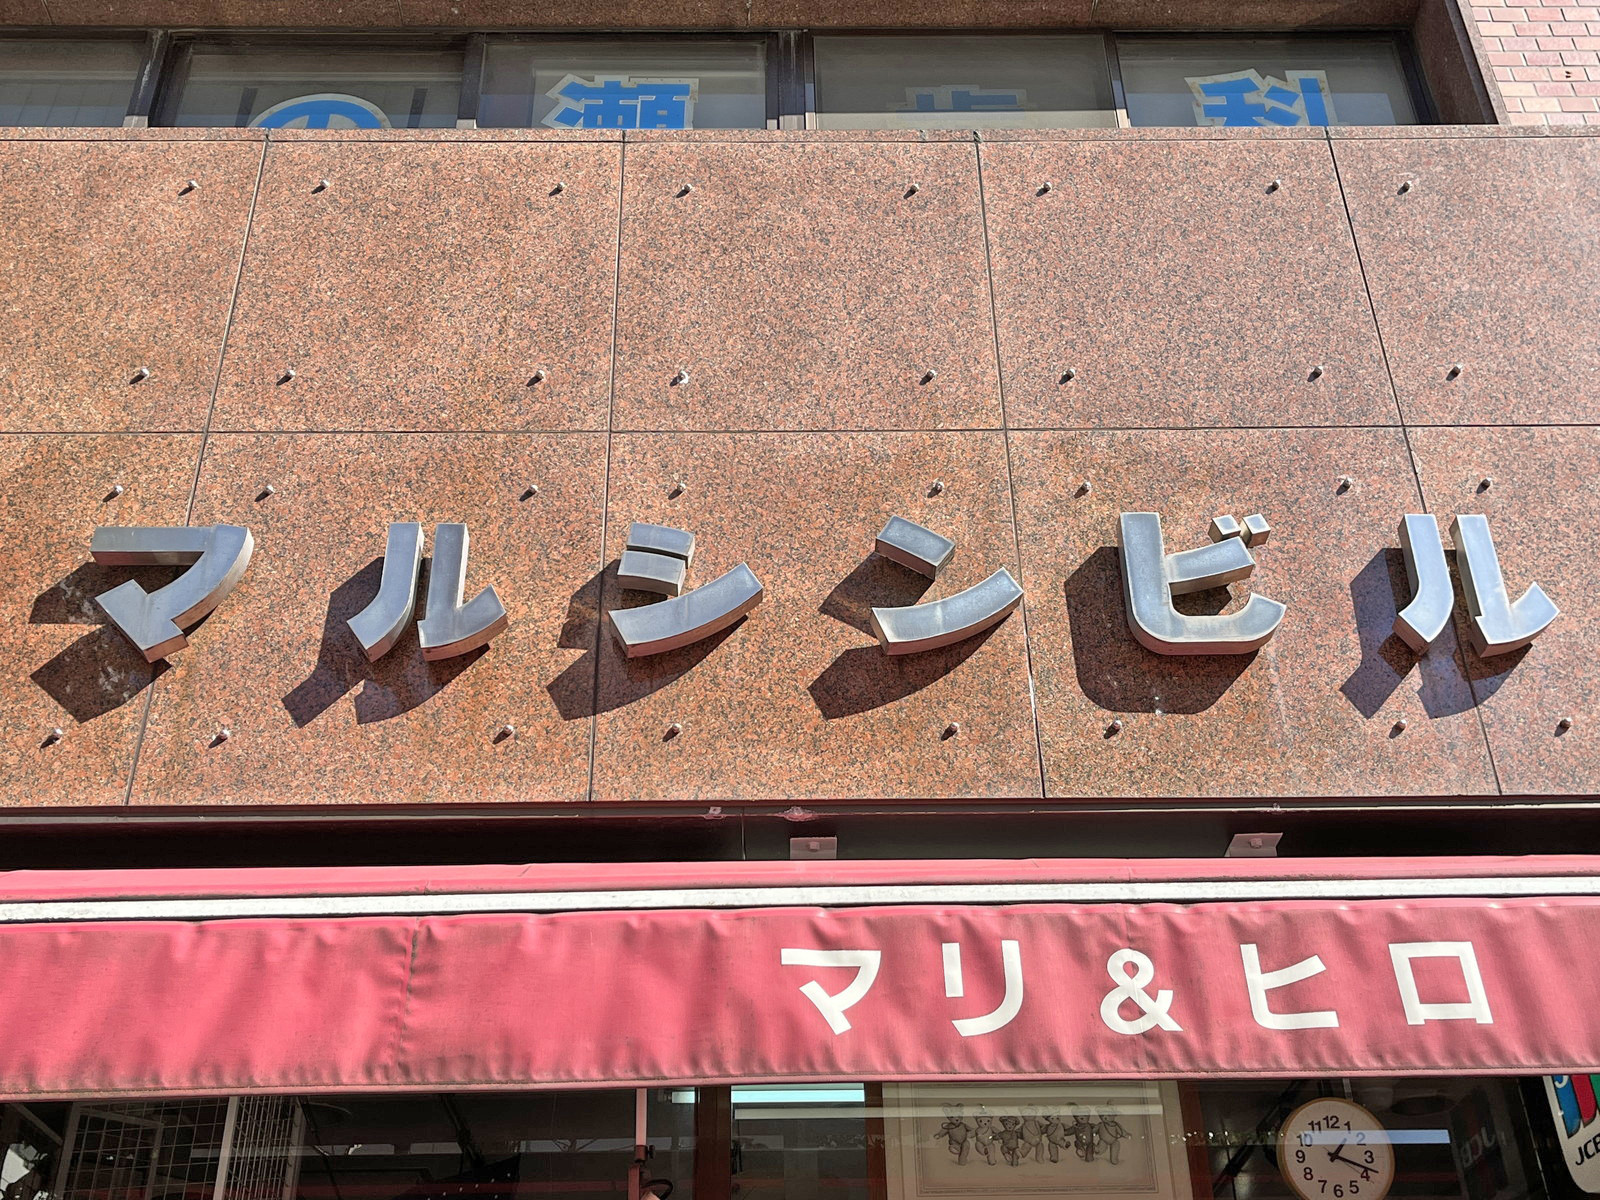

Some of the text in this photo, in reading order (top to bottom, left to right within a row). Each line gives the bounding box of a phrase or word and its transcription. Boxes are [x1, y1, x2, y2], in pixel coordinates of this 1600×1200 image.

[91, 512, 1560, 662] マルシンビル
[781, 939, 1494, 1037] マリ&ヒロ
[1308, 1120, 1322, 1133] 11
[1323, 1115, 1340, 1129] 12
[1344, 1121, 1351, 1134] 1
[1296, 1133, 1313, 1147] 10
[1356, 1132, 1366, 1146] 2
[1295, 1149, 1306, 1163] 9
[1364, 1150, 1374, 1164] 3
[1303, 1167, 1313, 1181] 8
[1360, 1168, 1370, 1182] 4
[1318, 1180, 1327, 1193] 7
[1333, 1184, 1344, 1198] 6
[1349, 1180, 1359, 1194] 5
